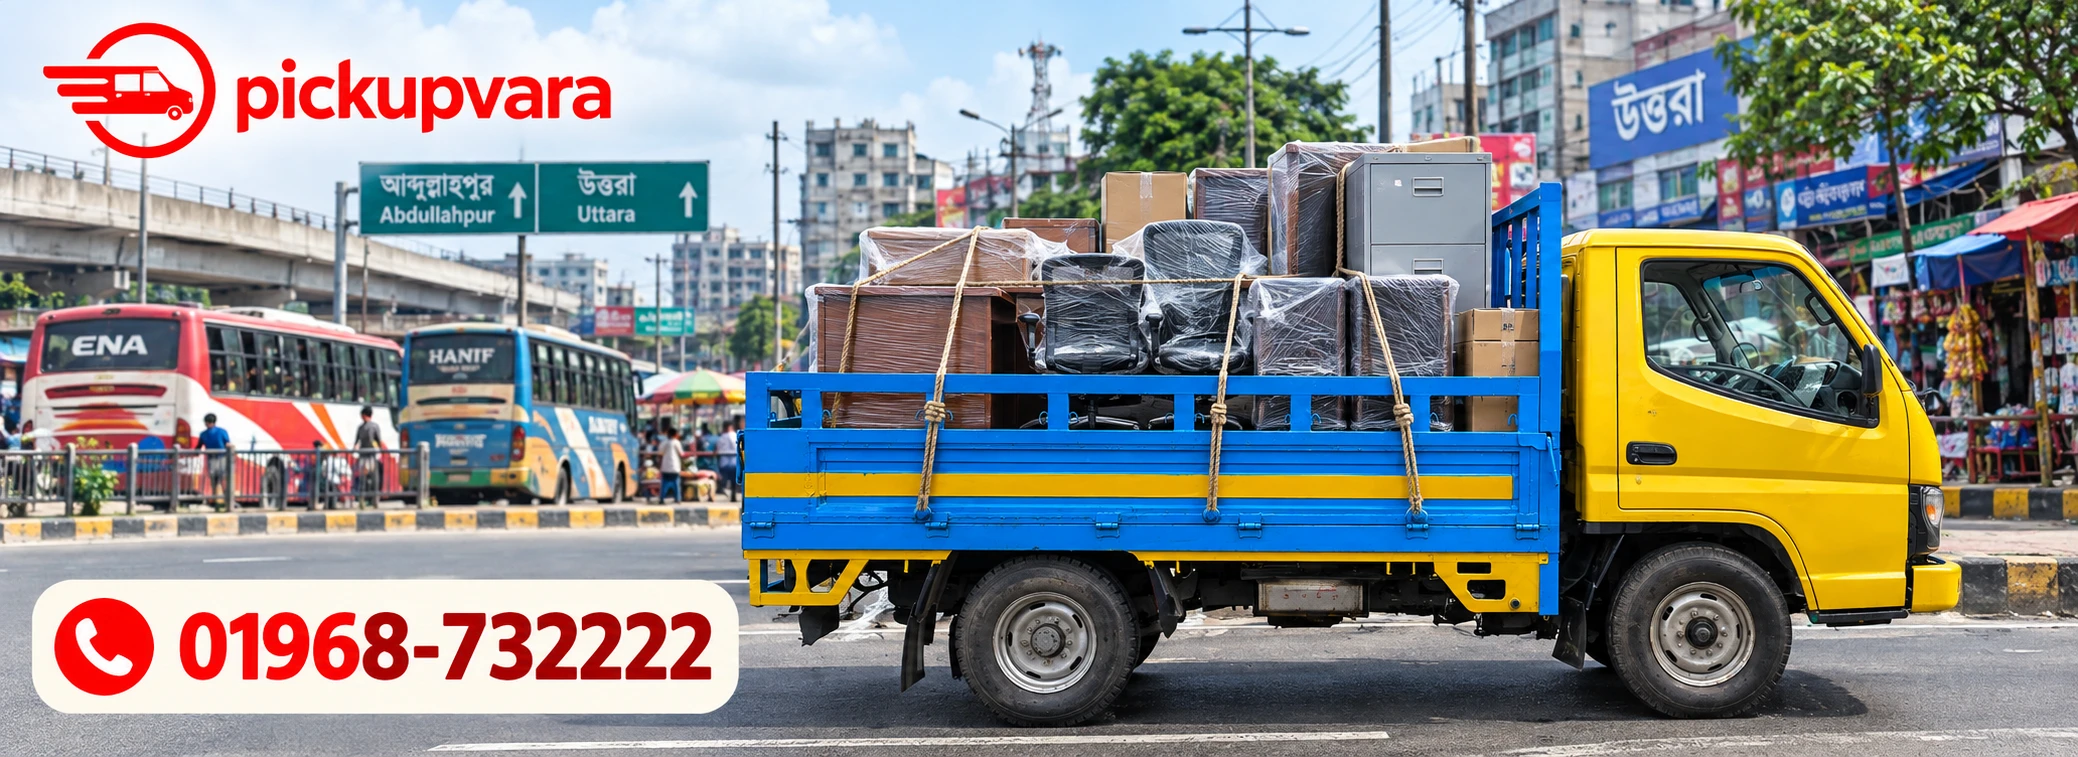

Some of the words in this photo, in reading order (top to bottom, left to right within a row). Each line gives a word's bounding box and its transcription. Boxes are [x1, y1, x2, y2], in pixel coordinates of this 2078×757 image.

[1611, 68, 1706, 141] উত্তরা
[577, 168, 636, 197] উত্তরা
[379, 205, 495, 228] Abdullahpur
[577, 205, 636, 223] Uttara
[71, 334, 148, 356] ENA
[428, 347, 495, 364] HANIF
